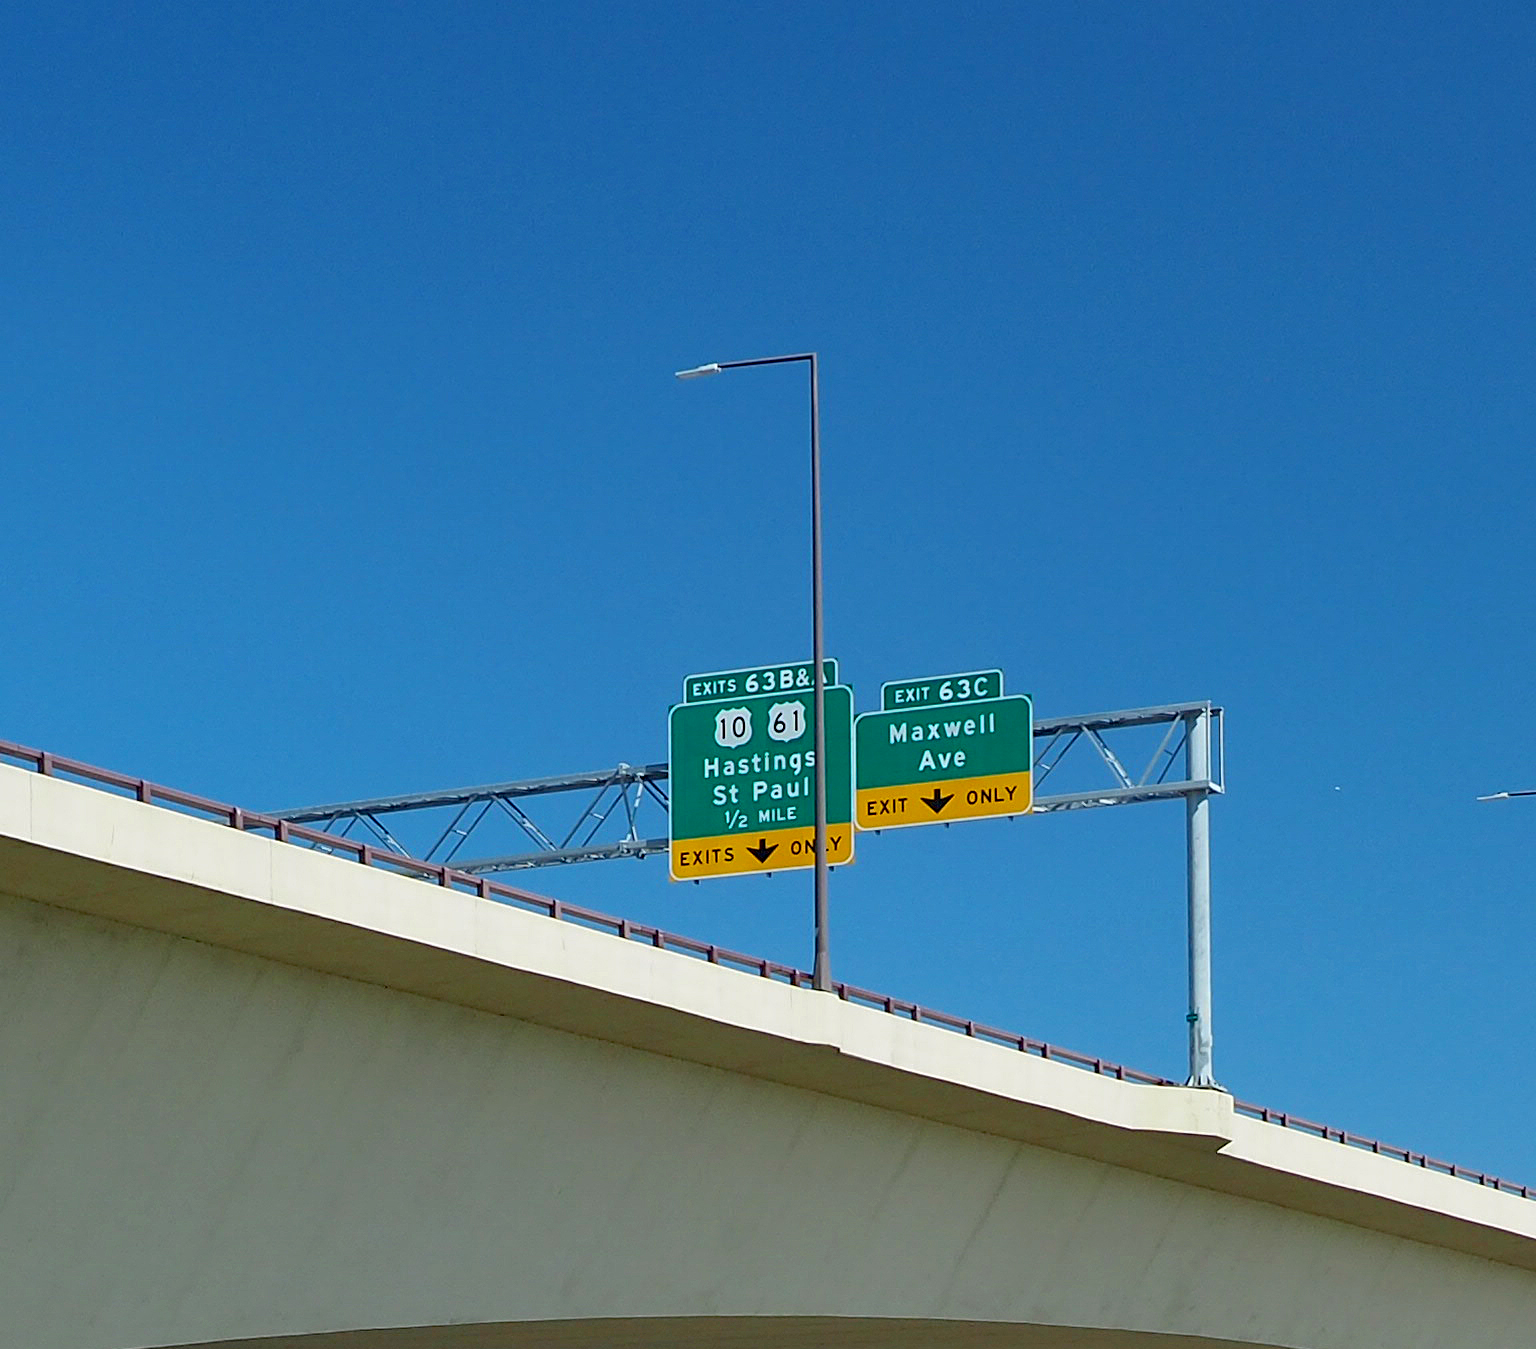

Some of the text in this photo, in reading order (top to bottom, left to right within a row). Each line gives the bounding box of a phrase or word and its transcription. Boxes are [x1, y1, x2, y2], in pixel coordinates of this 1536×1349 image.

[692, 678, 737, 697] EXITS
[894, 677, 988, 704] EXIT 63C
[720, 710, 798, 740] 10 61
[889, 712, 995, 744] Maxwell
[703, 750, 816, 779] Hastings
[918, 749, 966, 772] Ave
[713, 776, 809, 806] St Paul
[867, 785, 1017, 816] EXIT ONLY
[758, 806, 797, 824] MILE
[680, 835, 842, 867] EXITS ONY
